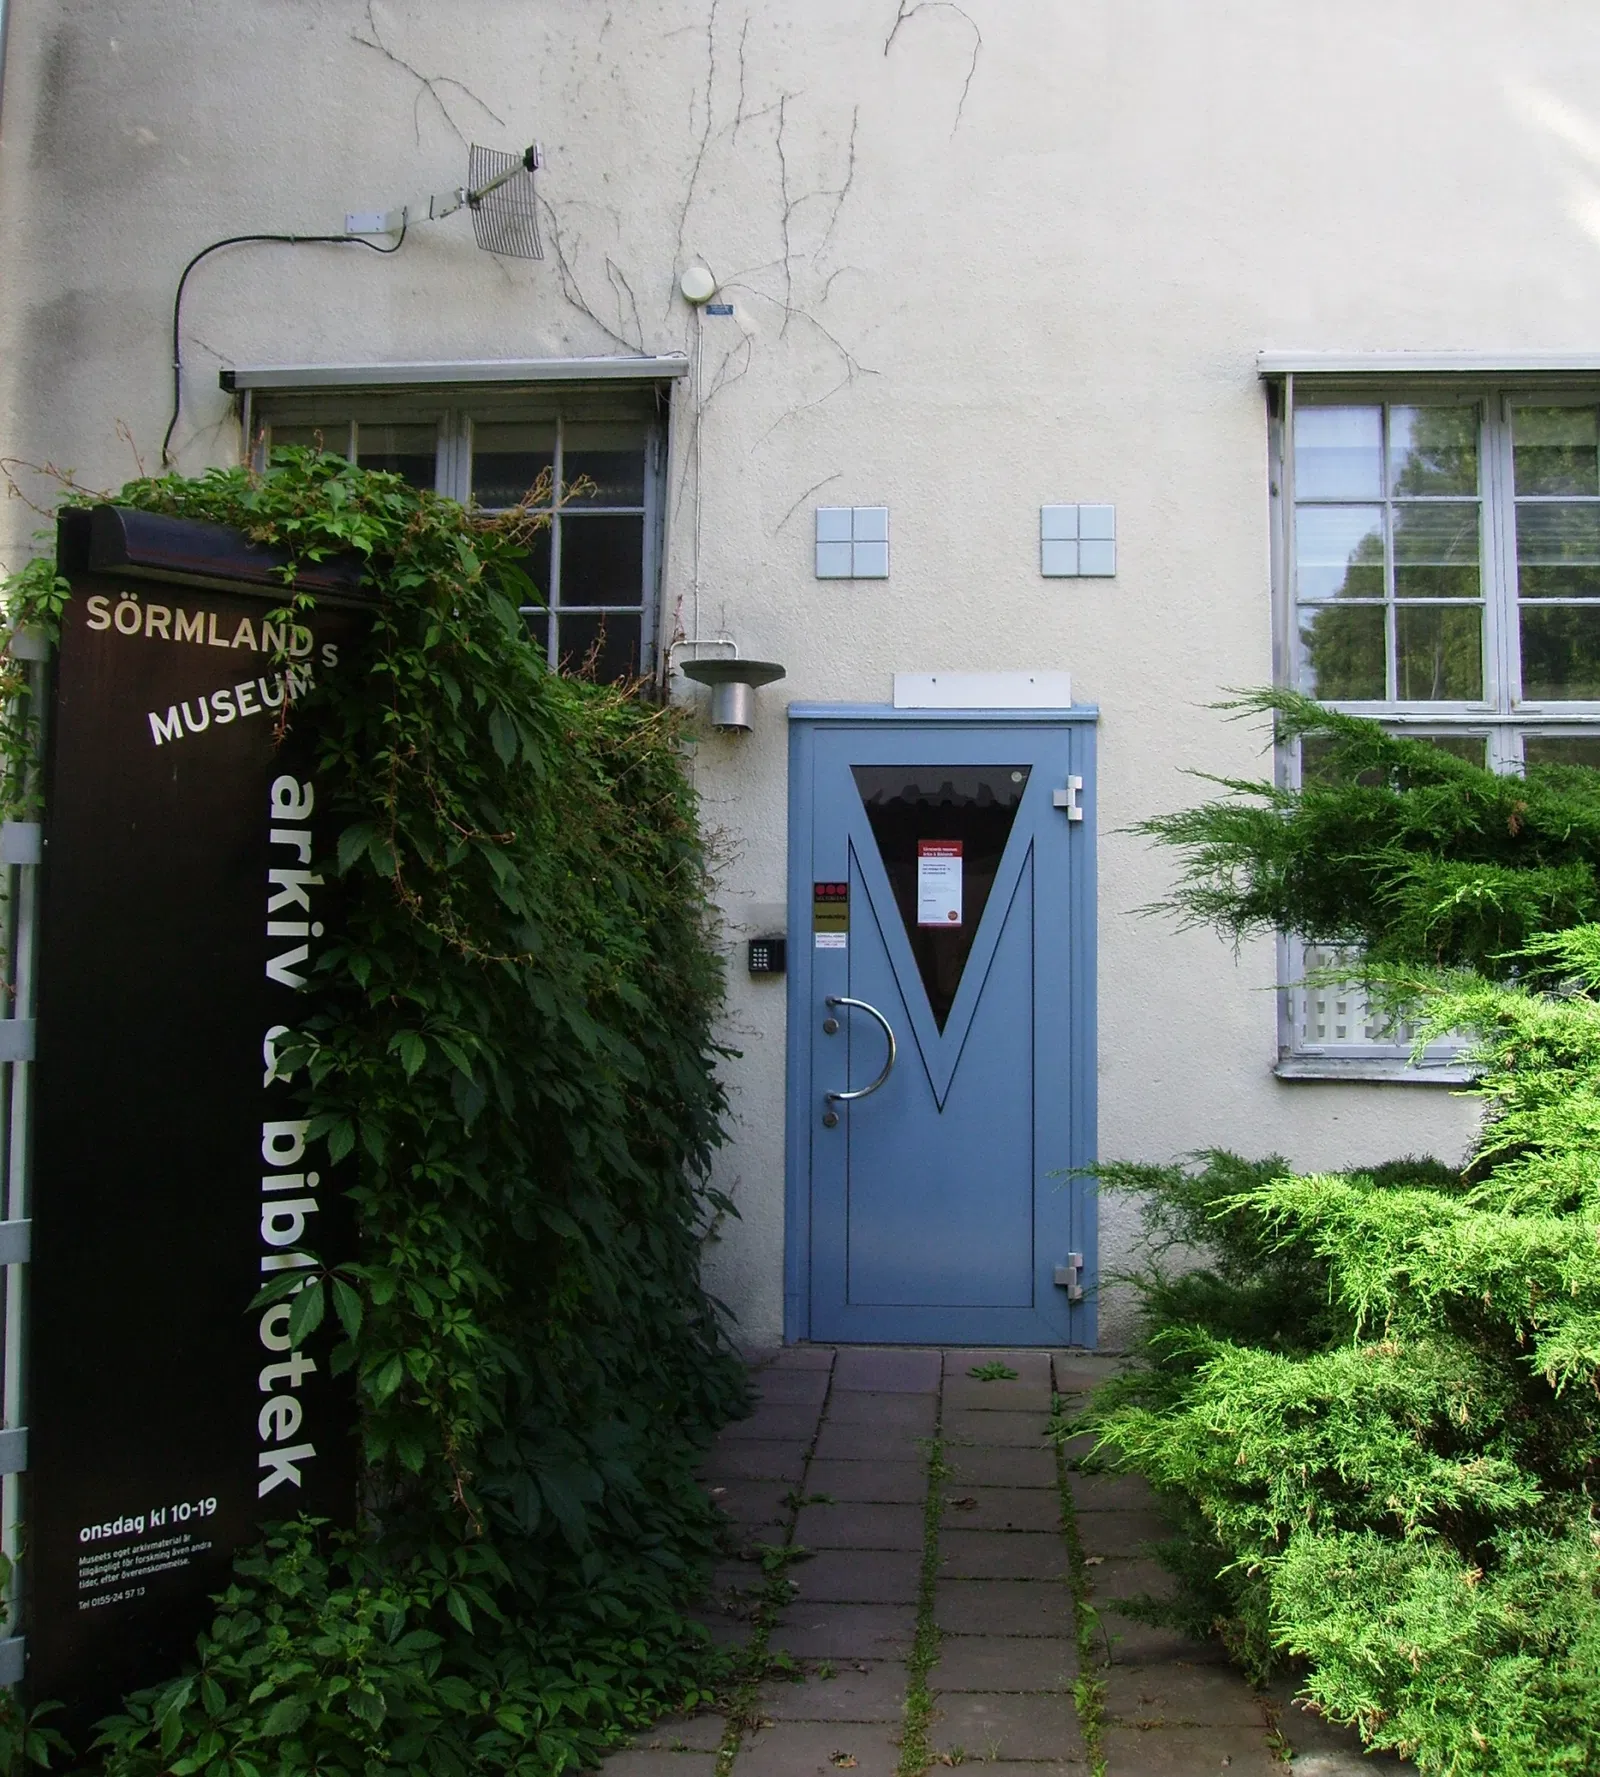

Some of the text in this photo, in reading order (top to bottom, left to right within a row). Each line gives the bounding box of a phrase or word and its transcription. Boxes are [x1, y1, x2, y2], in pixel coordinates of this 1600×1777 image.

[148, 662, 316, 745] MUSEUM
[266, 775, 325, 990] arkiv
[79, 1497, 217, 1542] onsdag kl 10-19
[78, 1533, 191, 1565] Museets eget arkivmaterial är
[79, 1541, 212, 1578] tillgängligt för forskning även andra
[101, 1572, 119, 1583] efter
[78, 1600, 90, 1610] Tel
[91, 1592, 123, 1607] 0155-24
[137, 1586, 146, 1597] 13
